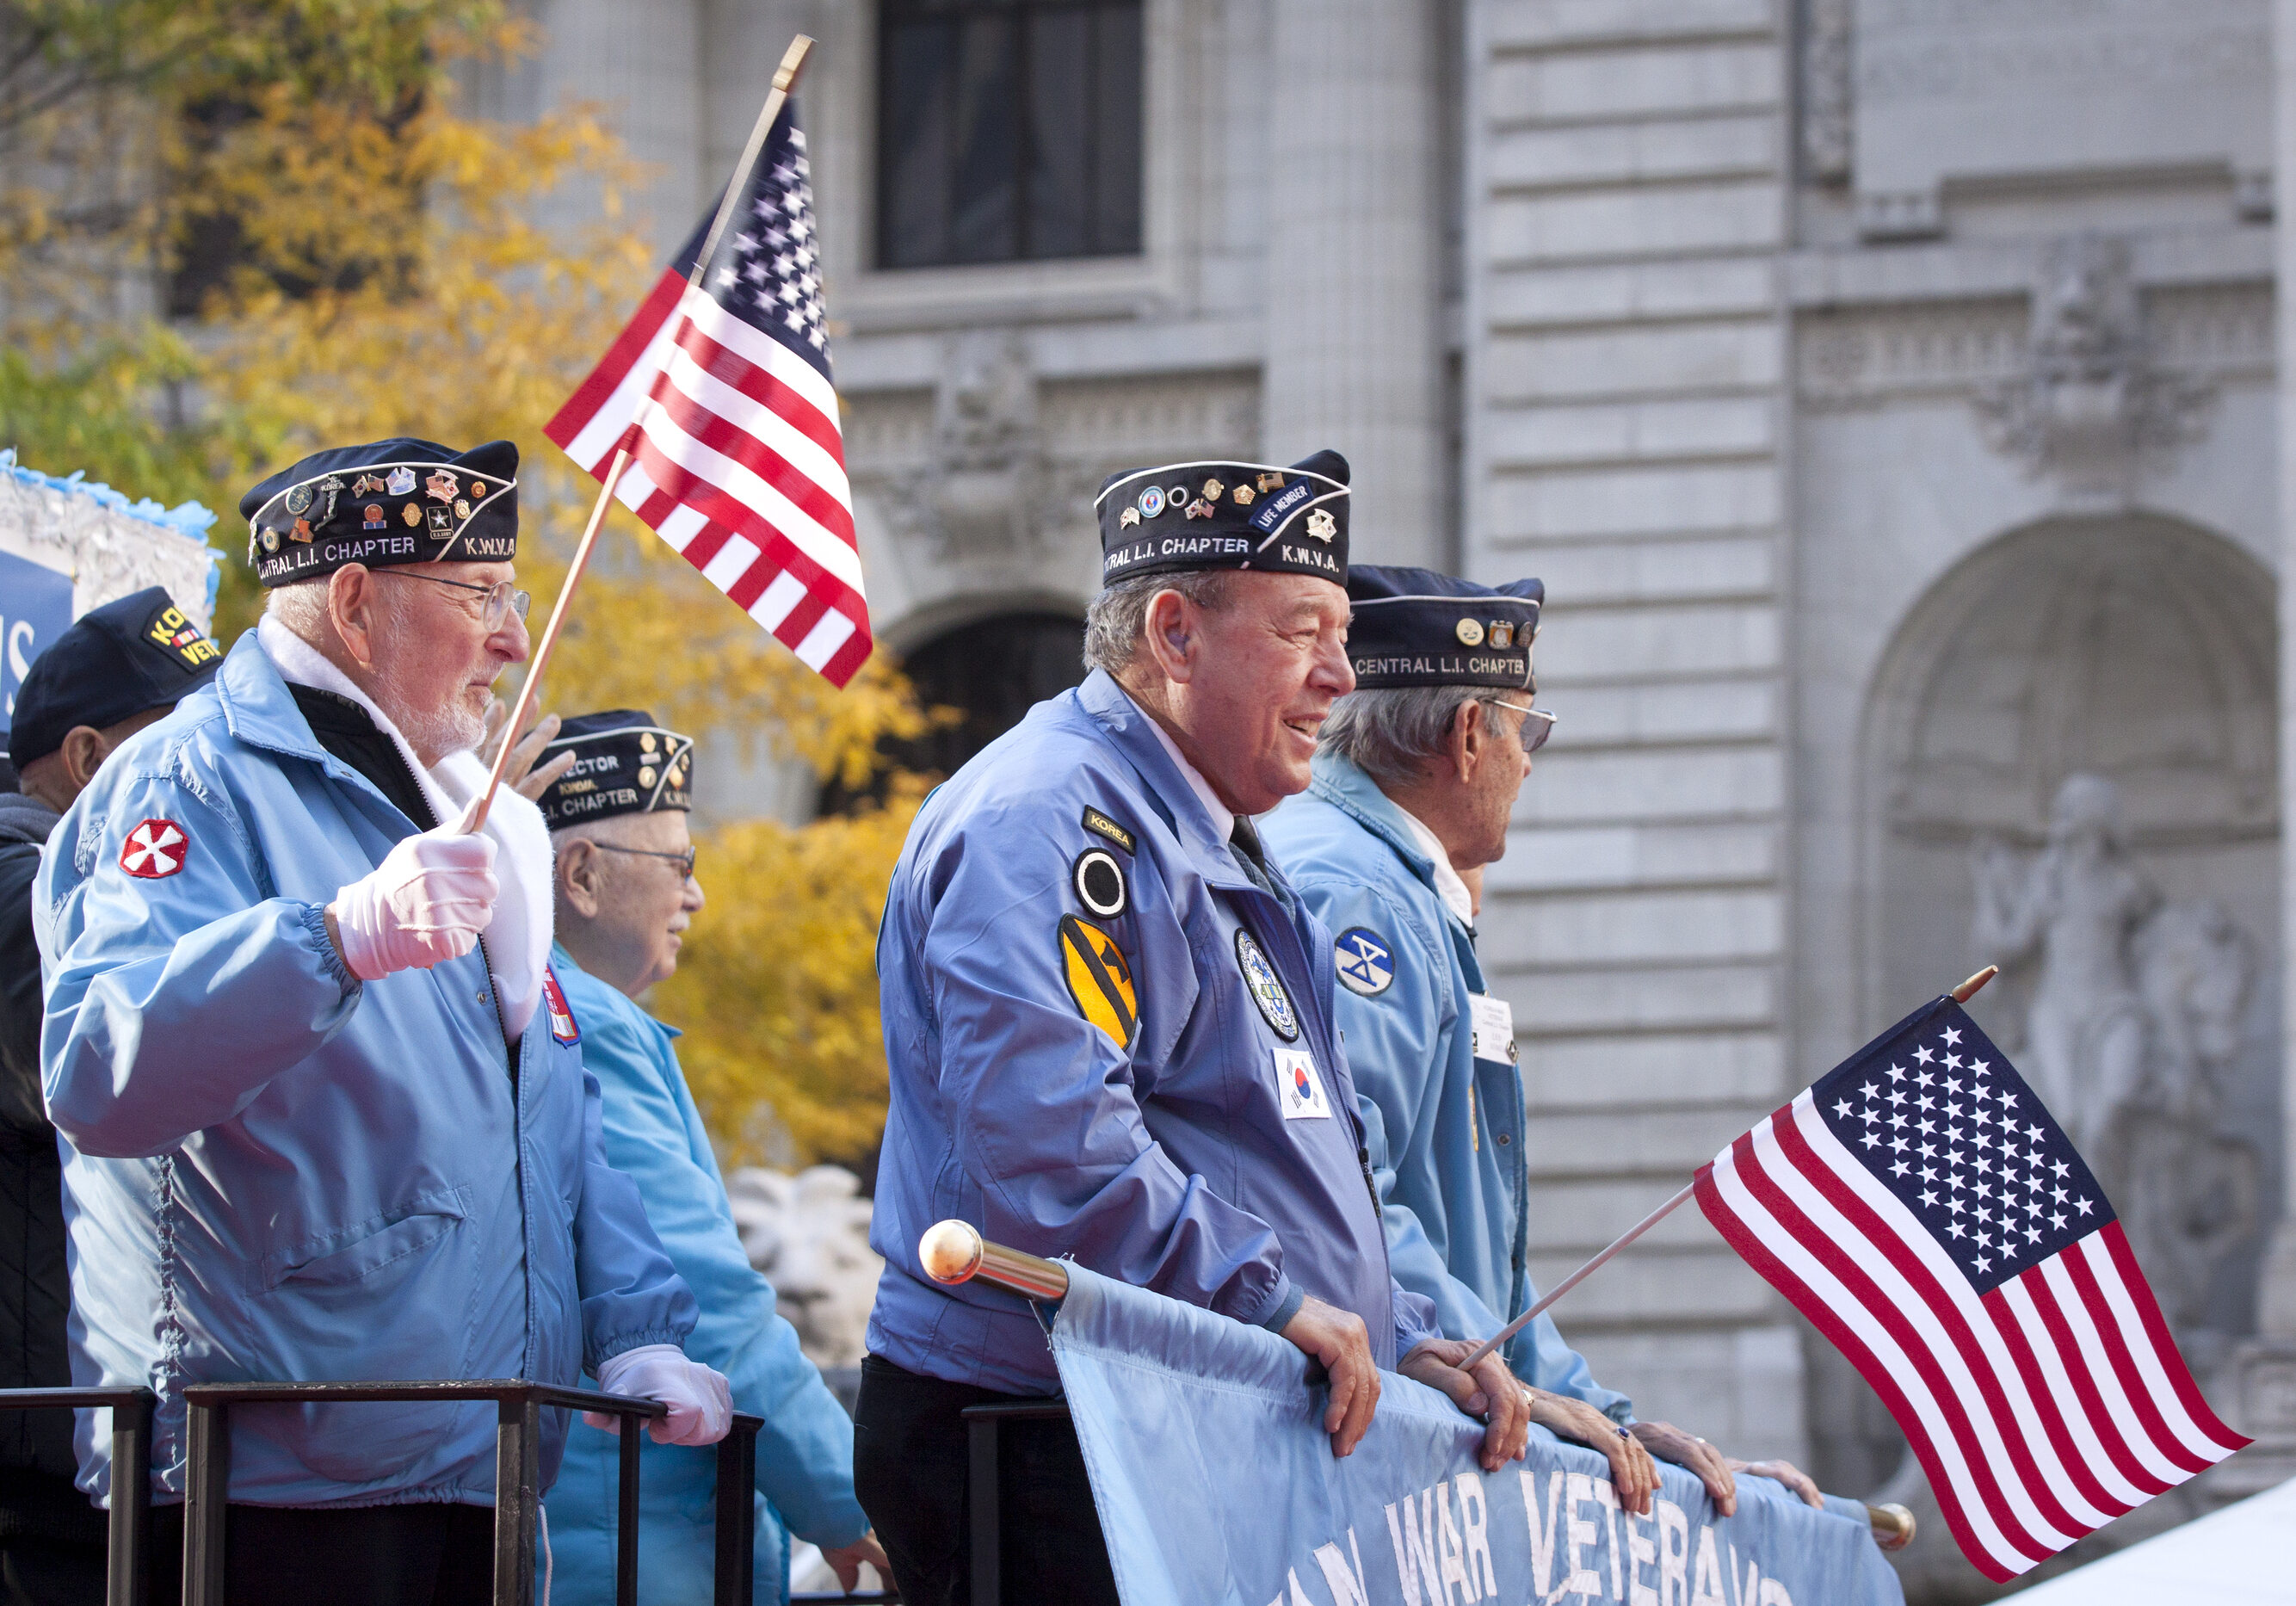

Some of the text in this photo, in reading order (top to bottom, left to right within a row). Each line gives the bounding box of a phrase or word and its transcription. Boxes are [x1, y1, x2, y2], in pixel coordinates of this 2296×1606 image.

[1258, 485, 1308, 528] LIFE MEMBER
[297, 548, 319, 567] L.I.
[324, 536, 416, 561] CHAPTER
[1104, 538, 1250, 572] TRAL L.I. CHAPTER
[1282, 544, 1340, 573] K.W.V.A.
[151, 607, 188, 646] KO
[1355, 657, 1525, 675] CENTRAL L.I. CHAPTER
[562, 788, 639, 816] CHAPTER
[1091, 814, 1130, 846] KOREA
[1384, 1473, 1498, 1606] WAR
[1519, 1471, 1794, 1606] VETERA
